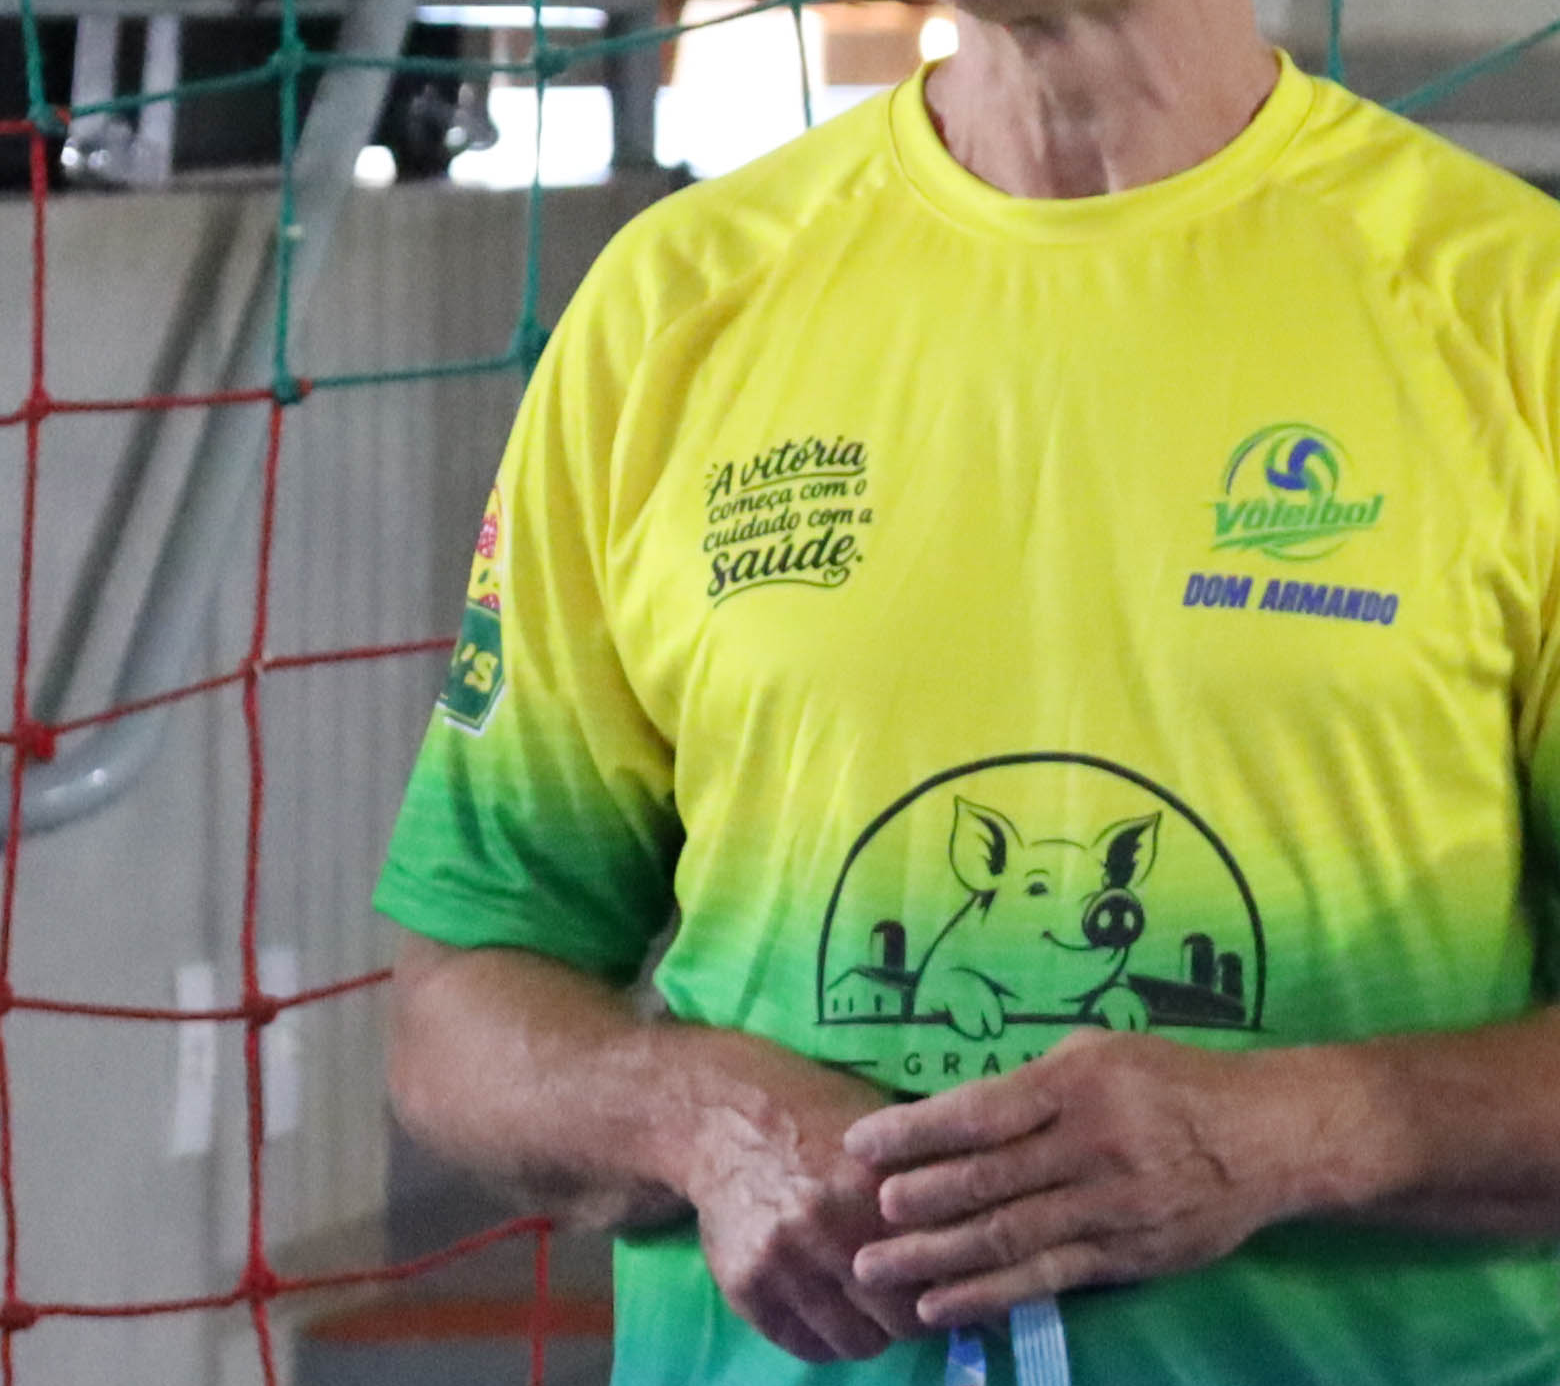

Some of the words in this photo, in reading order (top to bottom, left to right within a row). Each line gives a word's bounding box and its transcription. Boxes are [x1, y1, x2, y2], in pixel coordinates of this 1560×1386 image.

[706, 461, 734, 506] A
[799, 479, 847, 500] com
[807, 506, 852, 528] com
[1182, 572, 1253, 609] DOM
[1258, 578, 1398, 626] ARMANDO
